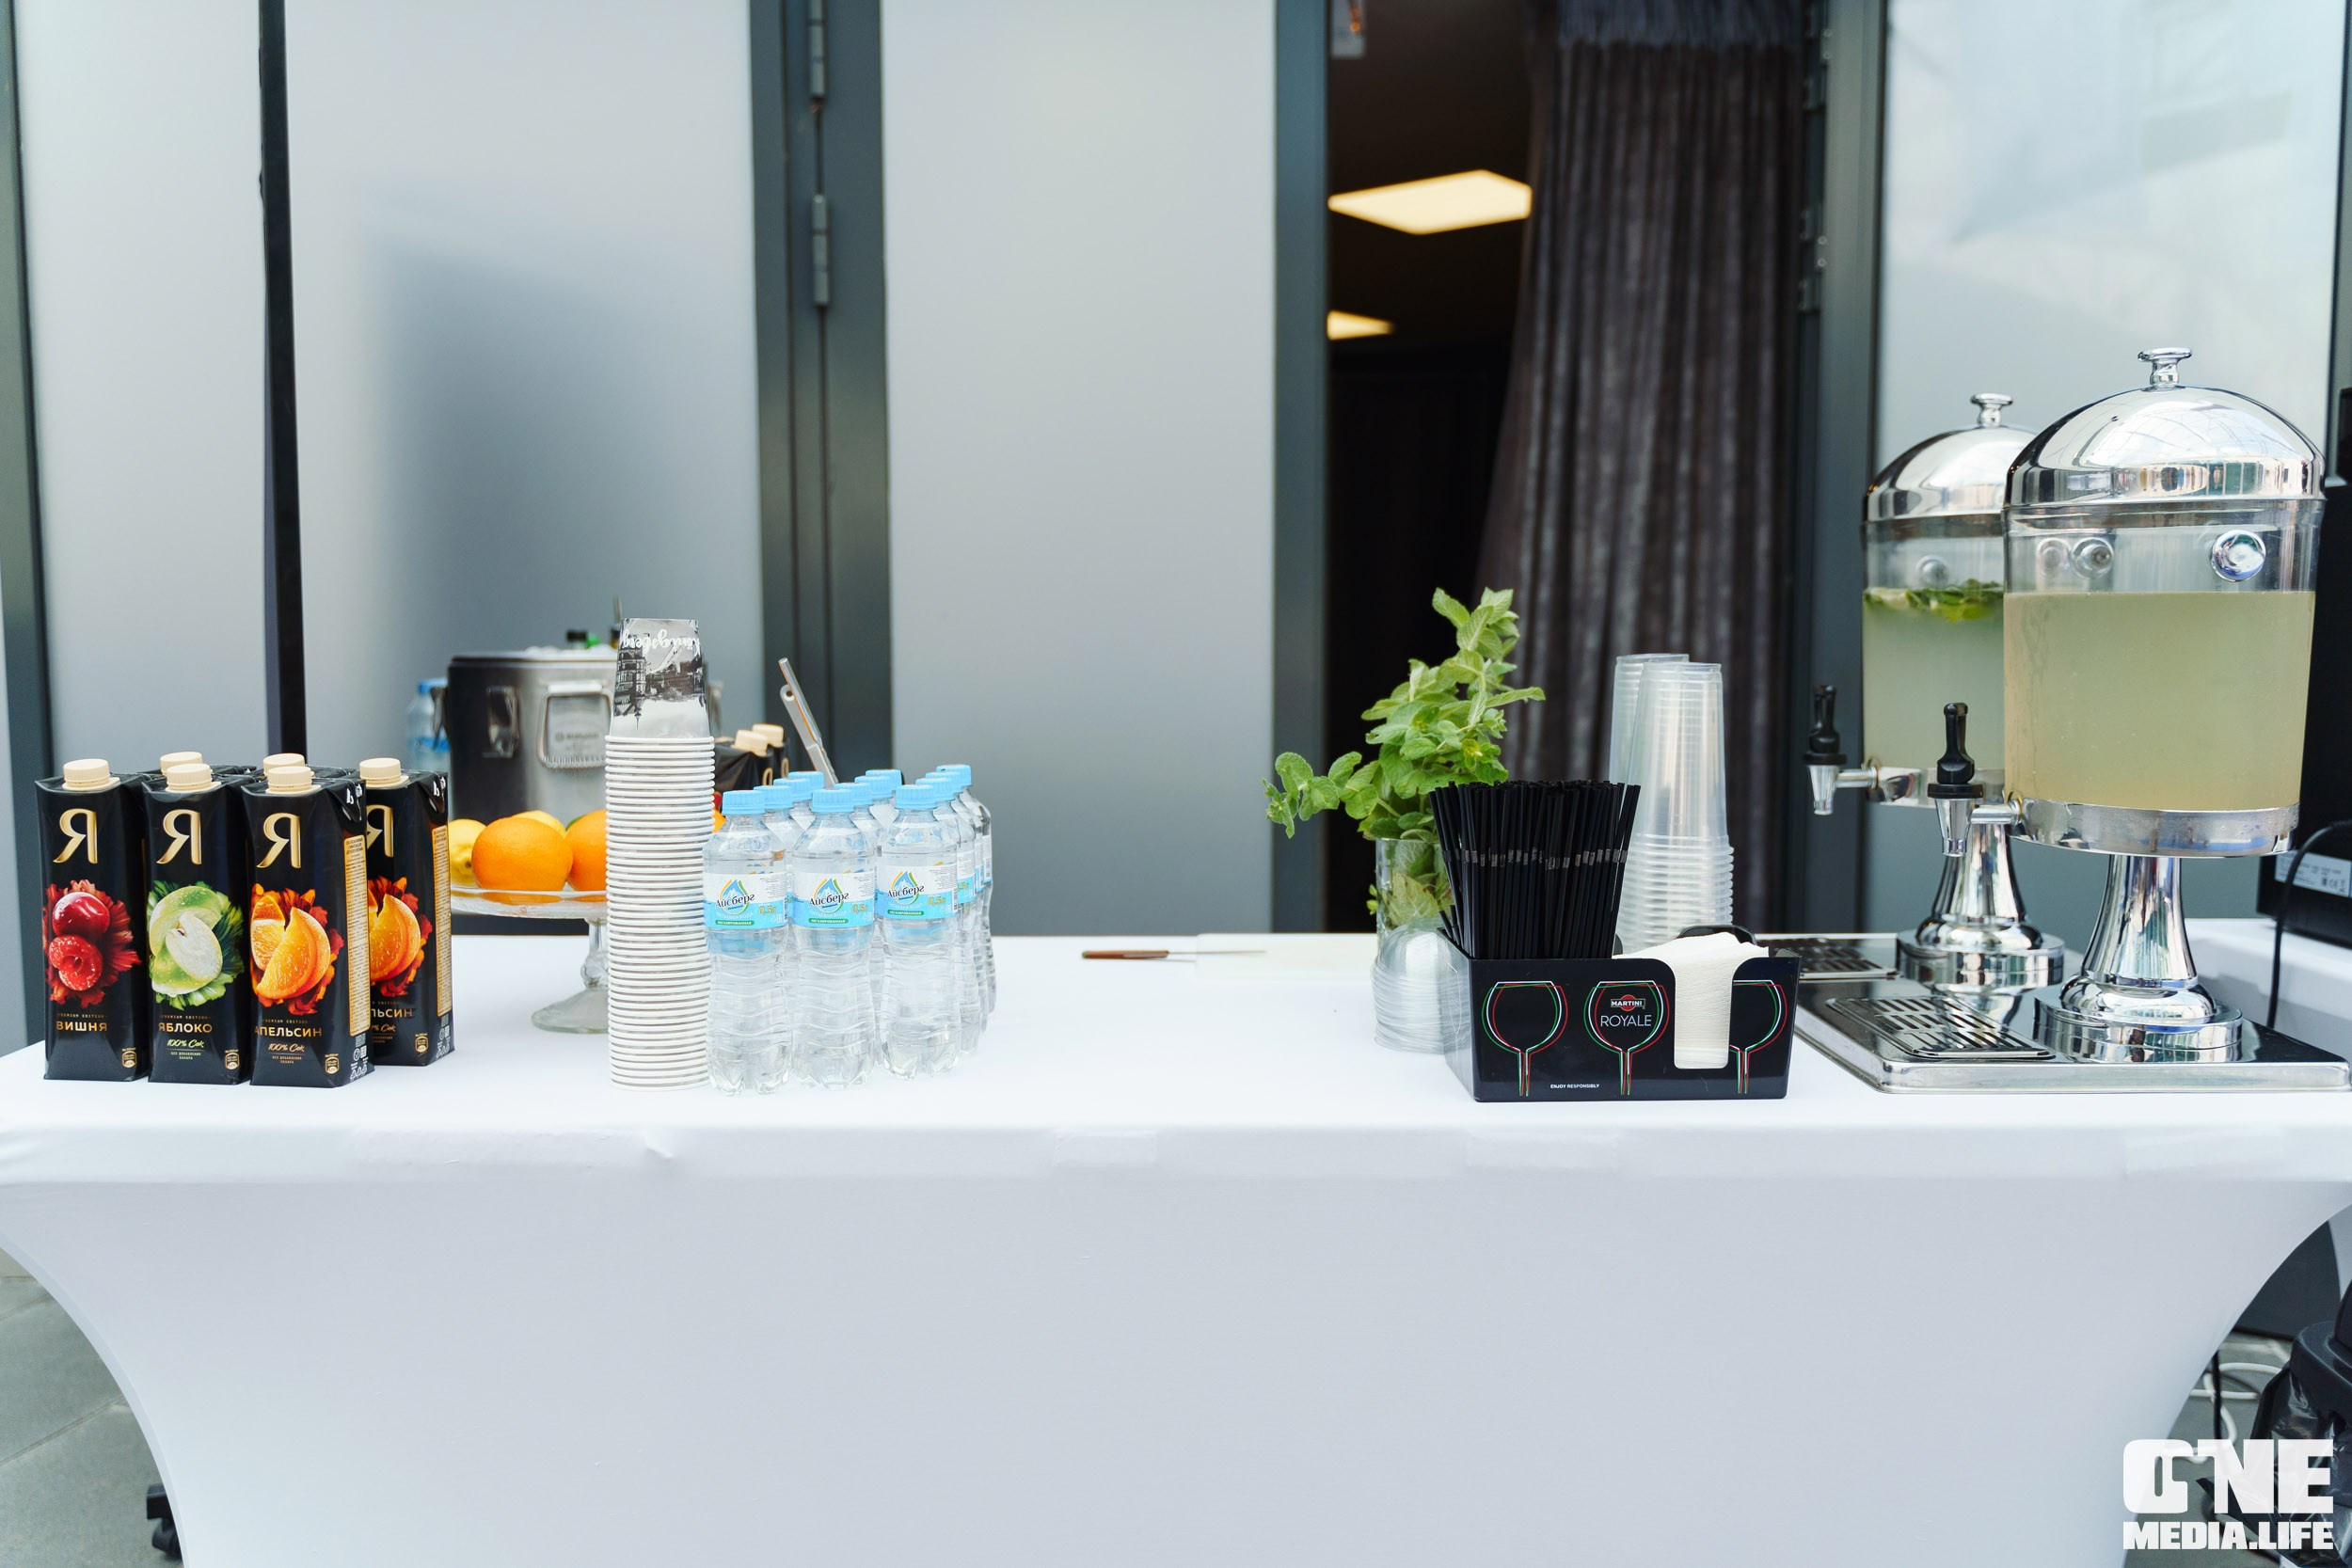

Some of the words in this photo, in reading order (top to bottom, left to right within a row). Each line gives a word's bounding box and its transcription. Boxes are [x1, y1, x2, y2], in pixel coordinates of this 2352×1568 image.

[53, 808, 98, 863] Я
[156, 809, 202, 864] Я
[257, 813, 301, 868] Я
[887, 885, 925, 898] Айсберг
[716, 894, 755, 908] Айсберг
[809, 893, 849, 906] Айсберг
[371, 1008, 413, 1018] ЛЬСИН
[56, 1021, 107, 1032] ВИШНЯ
[1600, 1014, 1652, 1027] ROYALE
[158, 1022, 213, 1034] ЯБЛОКО
[254, 1025, 323, 1037] АПЕЛЬСИН
[167, 1038, 187, 1047] 100%
[188, 1038, 205, 1049] Сок
[268, 1043, 288, 1052] 100%
[289, 1043, 306, 1053] Сок
